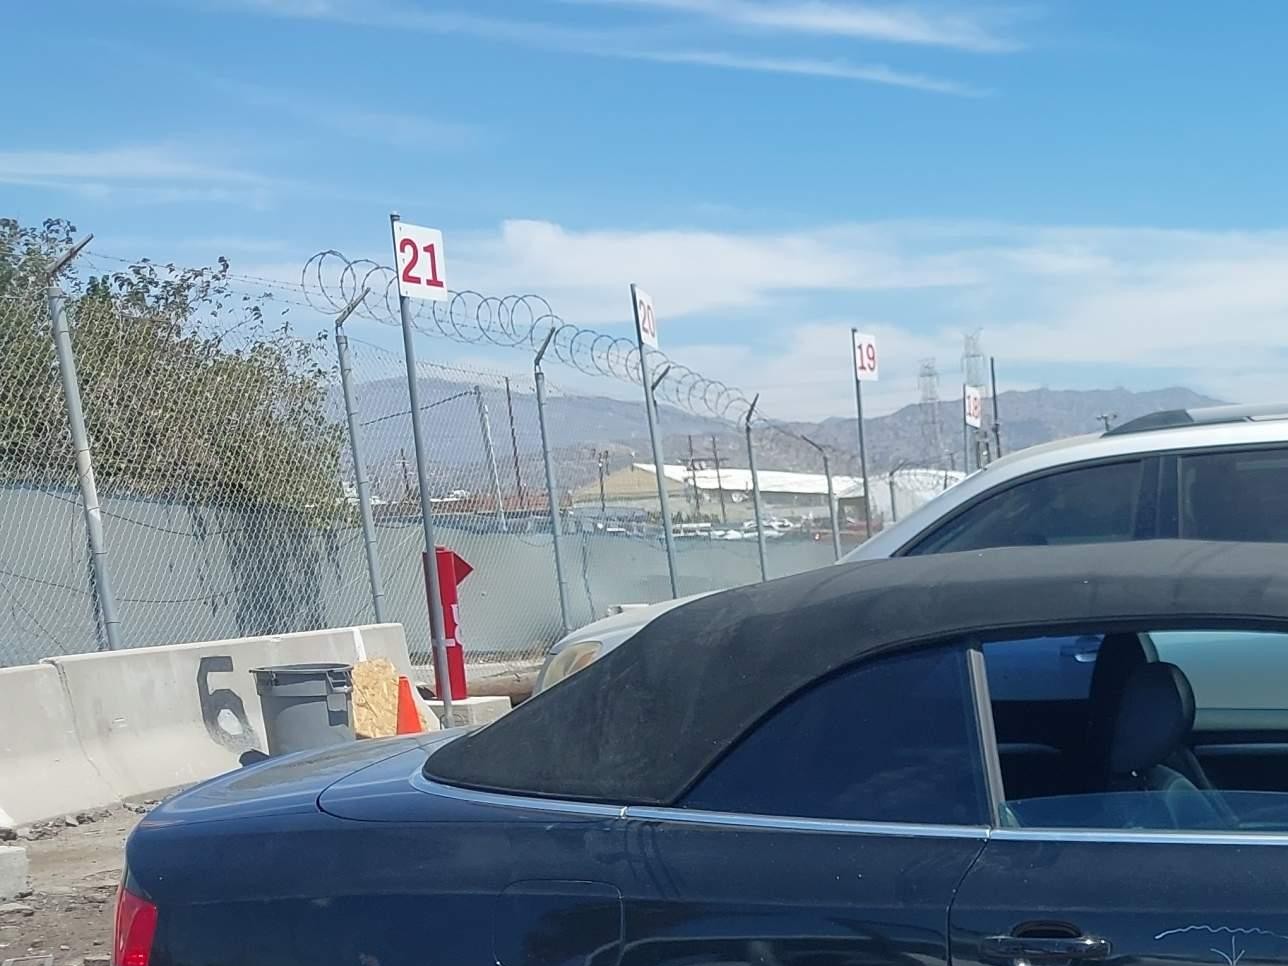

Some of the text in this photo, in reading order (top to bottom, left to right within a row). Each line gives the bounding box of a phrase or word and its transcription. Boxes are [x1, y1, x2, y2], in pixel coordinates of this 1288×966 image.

[399, 238, 444, 288] 21
[639, 299, 655, 338] 20
[857, 343, 876, 371] 19
[197, 656, 261, 753] 6
